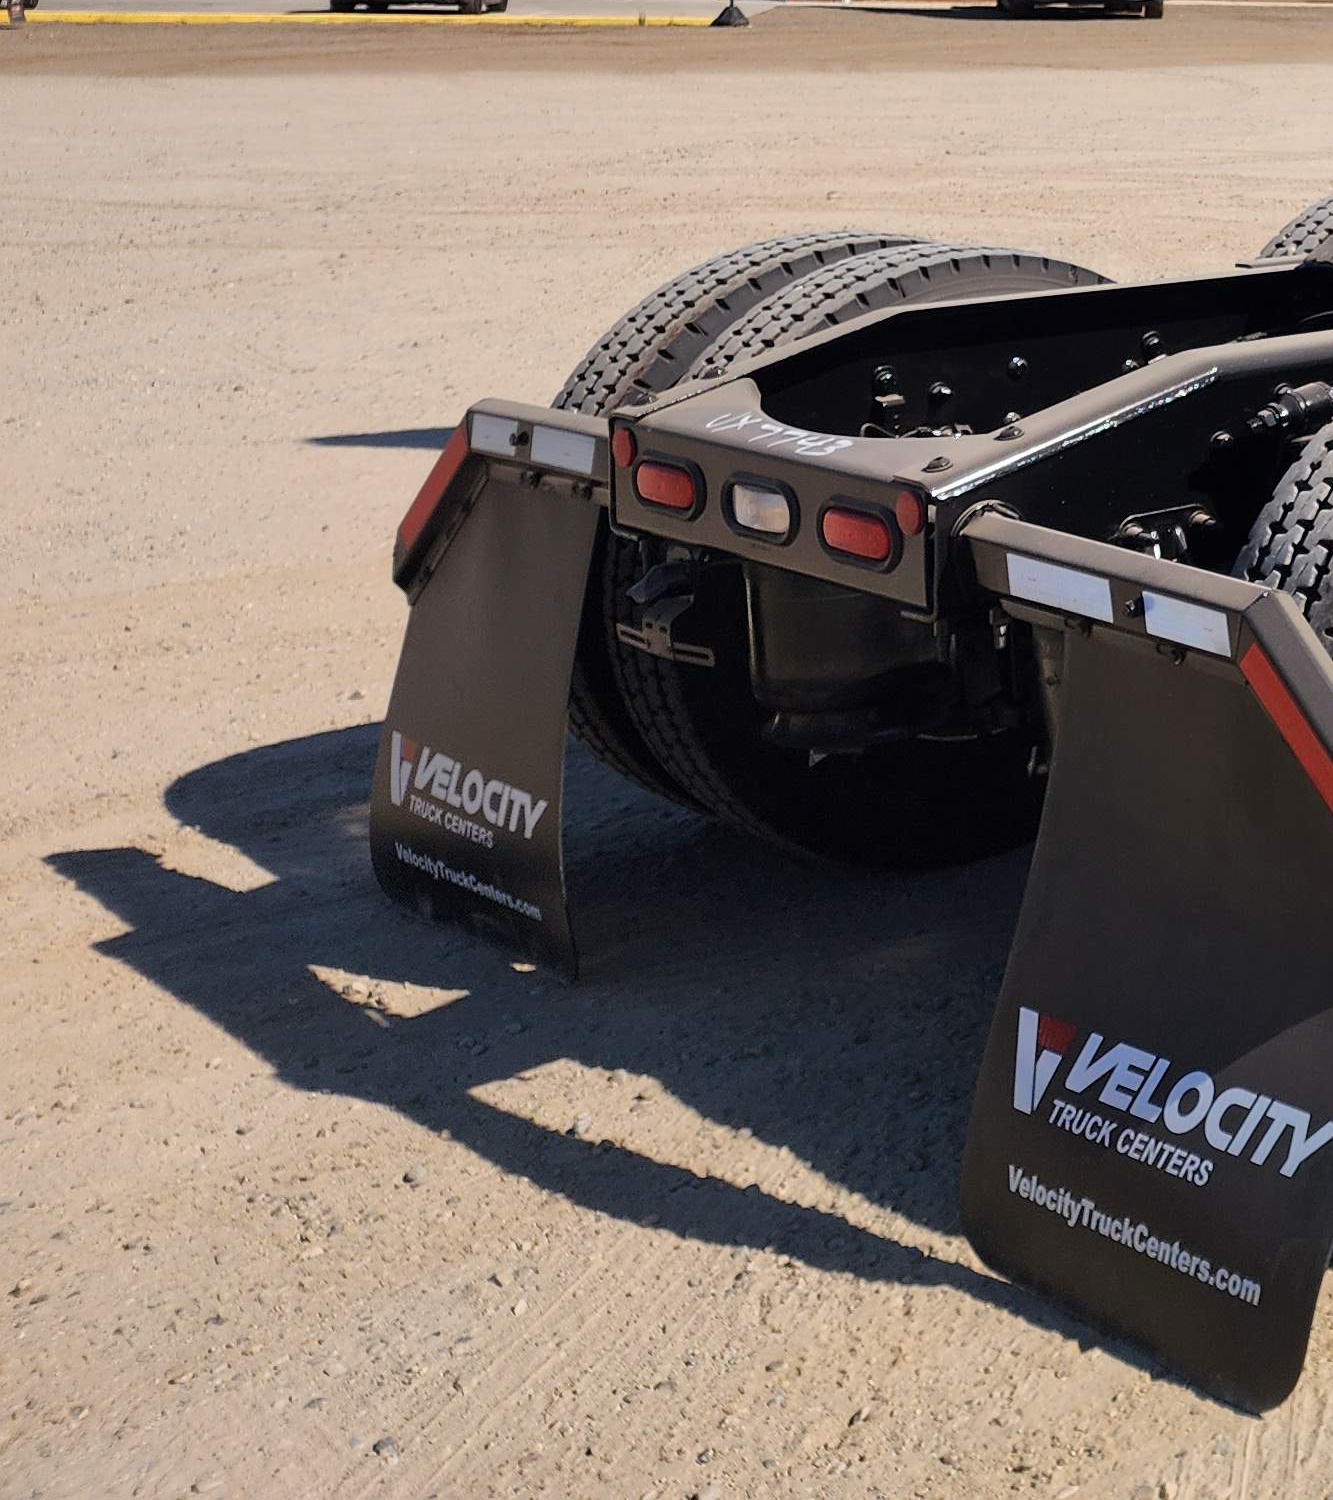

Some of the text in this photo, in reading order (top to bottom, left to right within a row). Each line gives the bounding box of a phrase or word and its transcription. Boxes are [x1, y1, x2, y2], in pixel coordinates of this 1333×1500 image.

[748, 423, 853, 456] 7743
[409, 794, 494, 849] TRUCK CENTERS
[414, 746, 549, 839] VELOCITY
[1048, 1099, 1214, 1187] TRUCK CENTERS
[1008, 1164, 1262, 1306] VelocityTruckCenters.com
